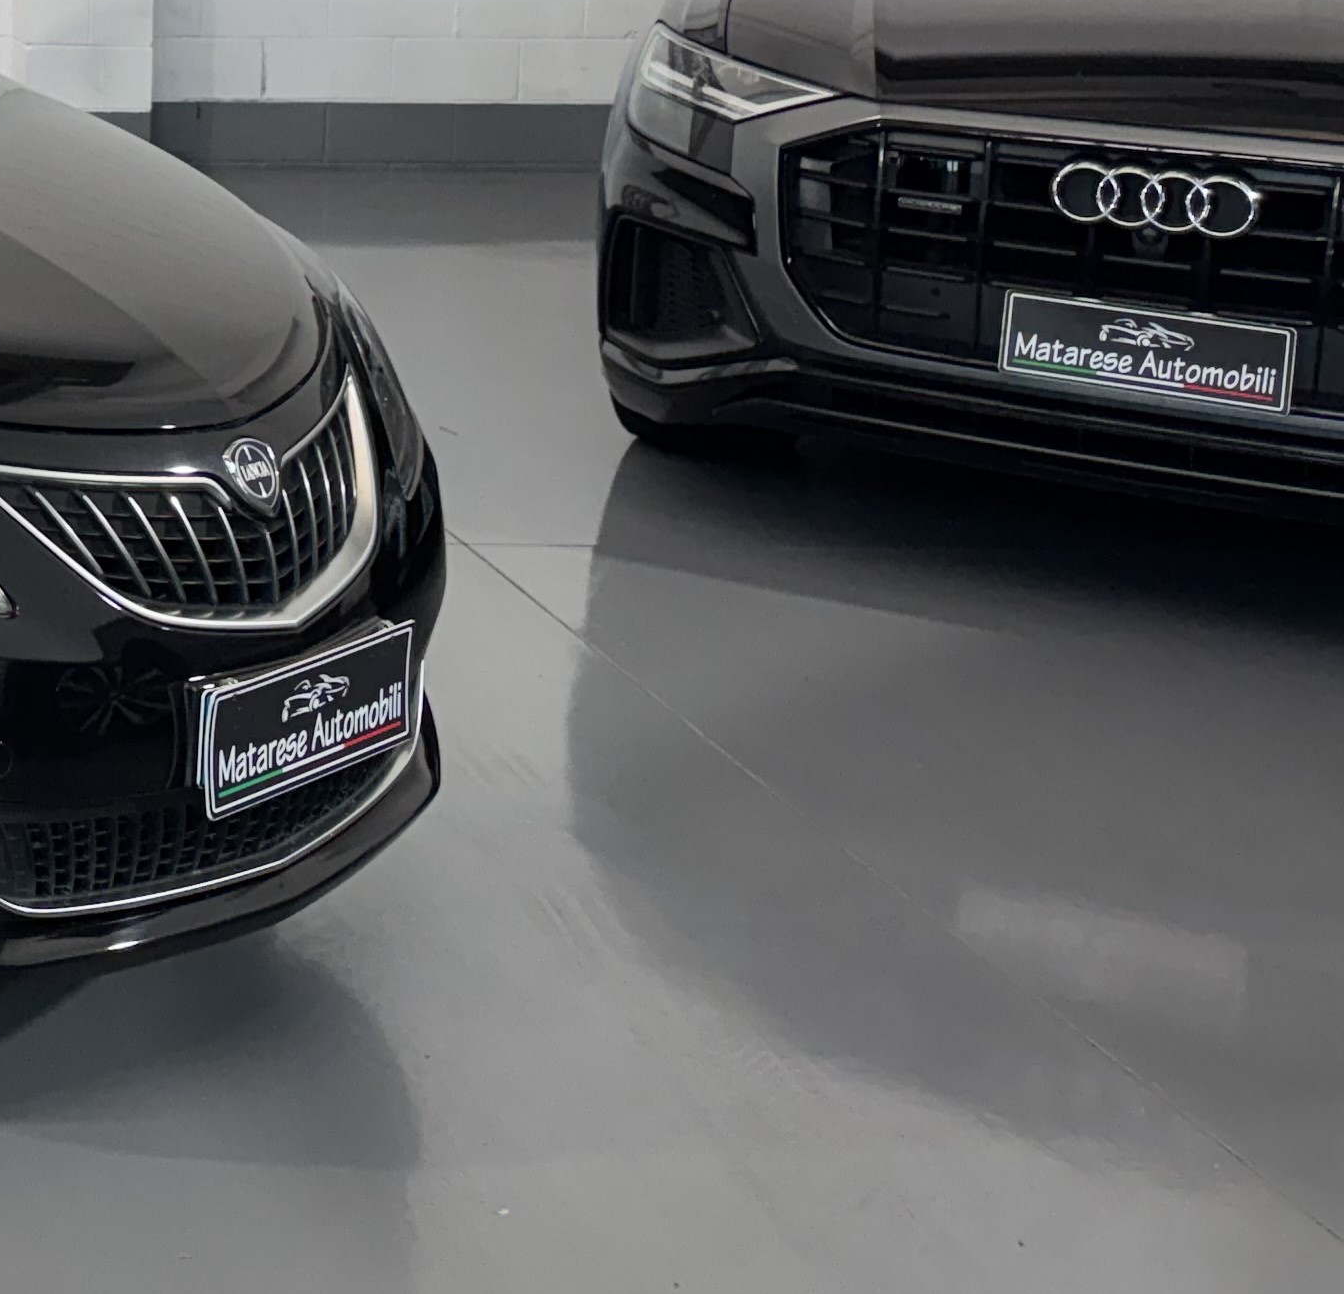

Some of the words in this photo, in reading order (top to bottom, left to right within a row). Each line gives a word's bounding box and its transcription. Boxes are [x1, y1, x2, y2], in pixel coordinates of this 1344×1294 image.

[1014, 330, 1133, 374] Matarese
[1138, 349, 1277, 395] Automobili
[218, 729, 308, 788] Matarese
[311, 681, 403, 752] Automobili
